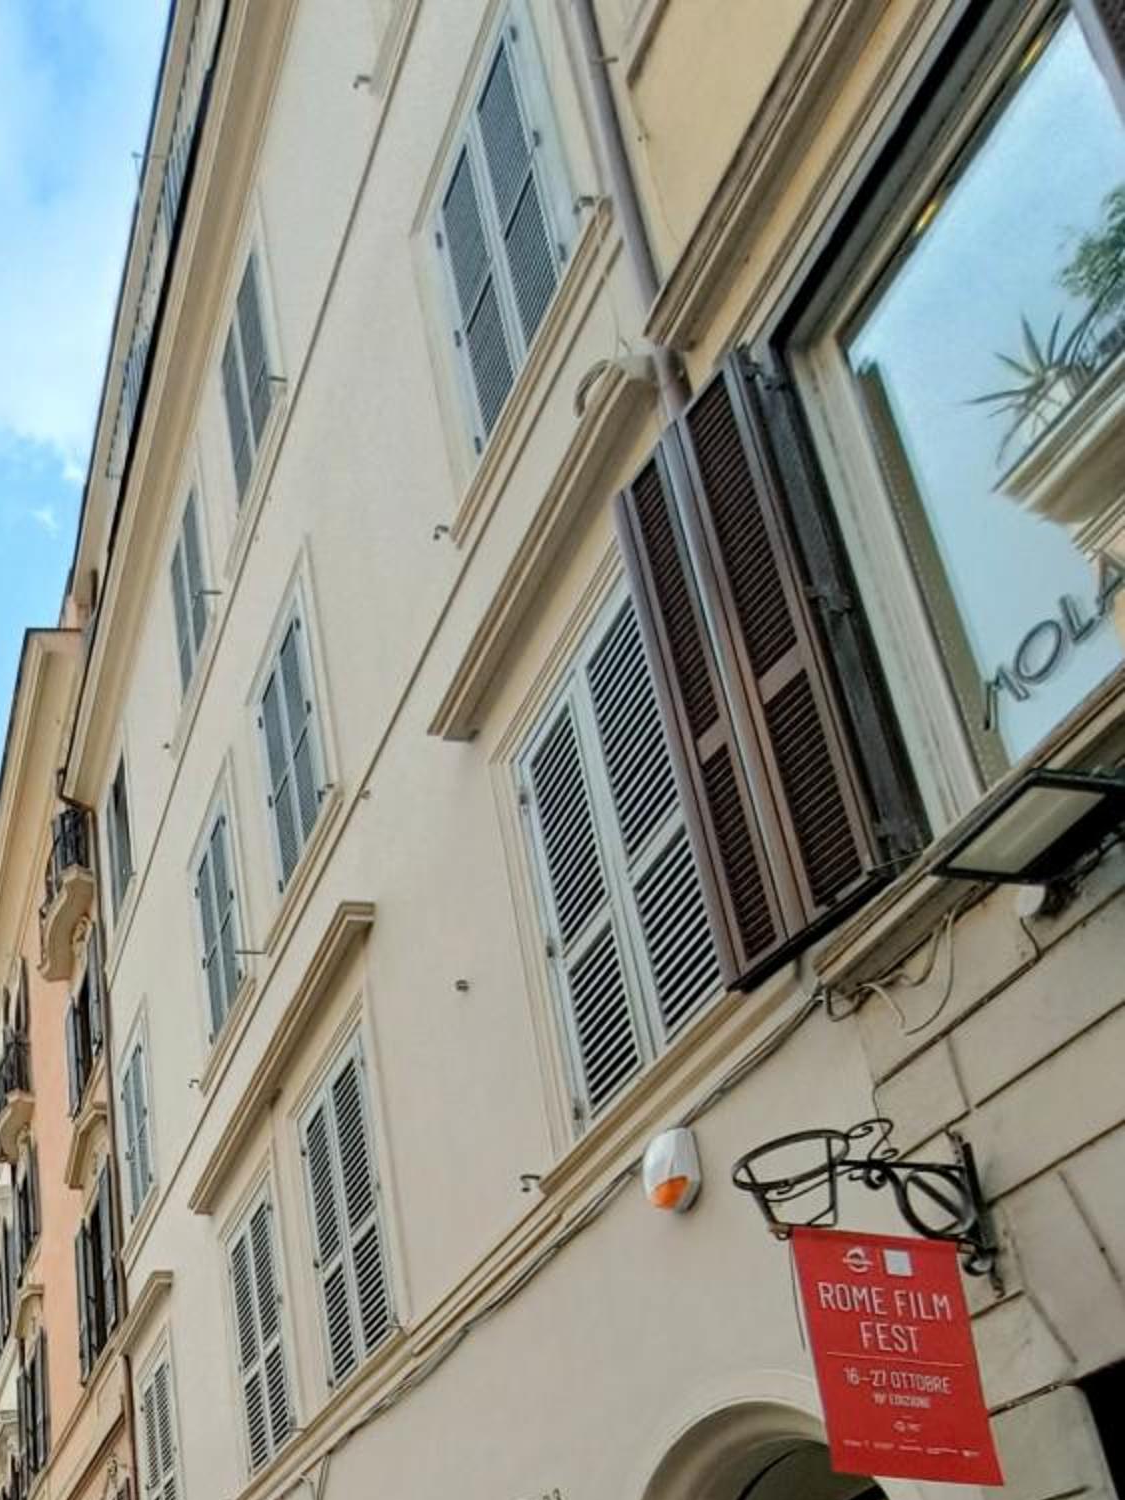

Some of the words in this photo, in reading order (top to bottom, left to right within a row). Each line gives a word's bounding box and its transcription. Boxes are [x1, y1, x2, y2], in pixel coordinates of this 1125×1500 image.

[818, 1281, 888, 1315] ROME
[893, 1289, 953, 1321] FILM
[859, 1321, 919, 1353] FEST
[890, 1371, 952, 1395] OTTOBRE
